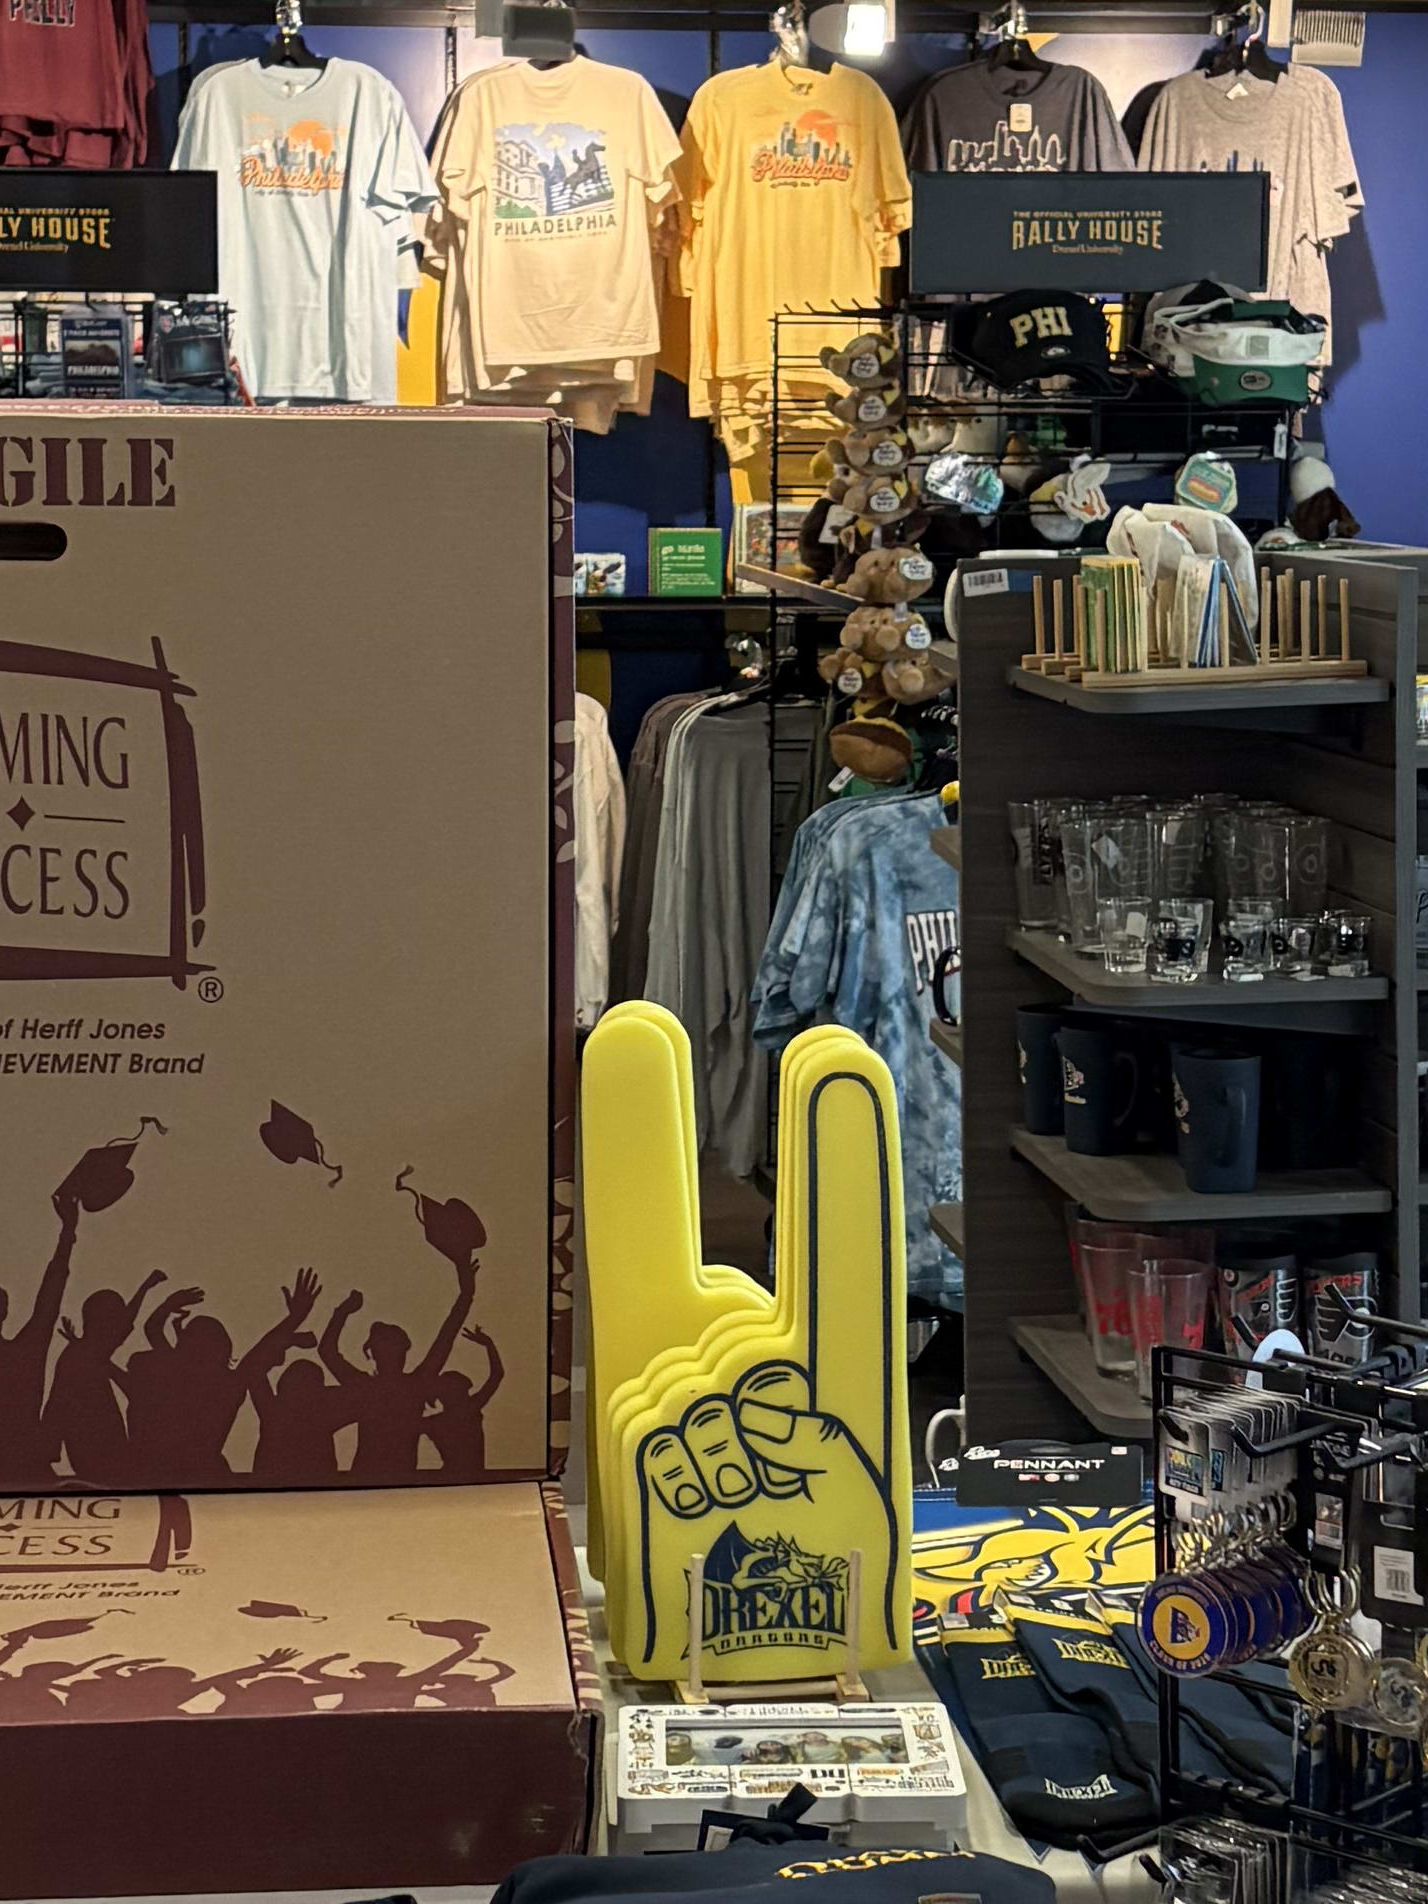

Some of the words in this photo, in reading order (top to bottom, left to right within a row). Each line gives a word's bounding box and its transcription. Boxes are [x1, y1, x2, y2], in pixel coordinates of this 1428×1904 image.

[31, 216, 112, 249] HOUSE
[493, 213, 618, 238] PHILADELPHIA
[1012, 219, 1078, 251] RALLY
[1088, 220, 1164, 251] HOUSE
[20, 1018, 84, 1041] Herff
[89, 1018, 166, 1041] Jones
[128, 1052, 205, 1075] Brand
[993, 1458, 1106, 1471] PENNANT
[56, 1580, 139, 1590] Jones
[96, 1588, 180, 1599] Brand
[700, 1581, 847, 1642] DREXEL
